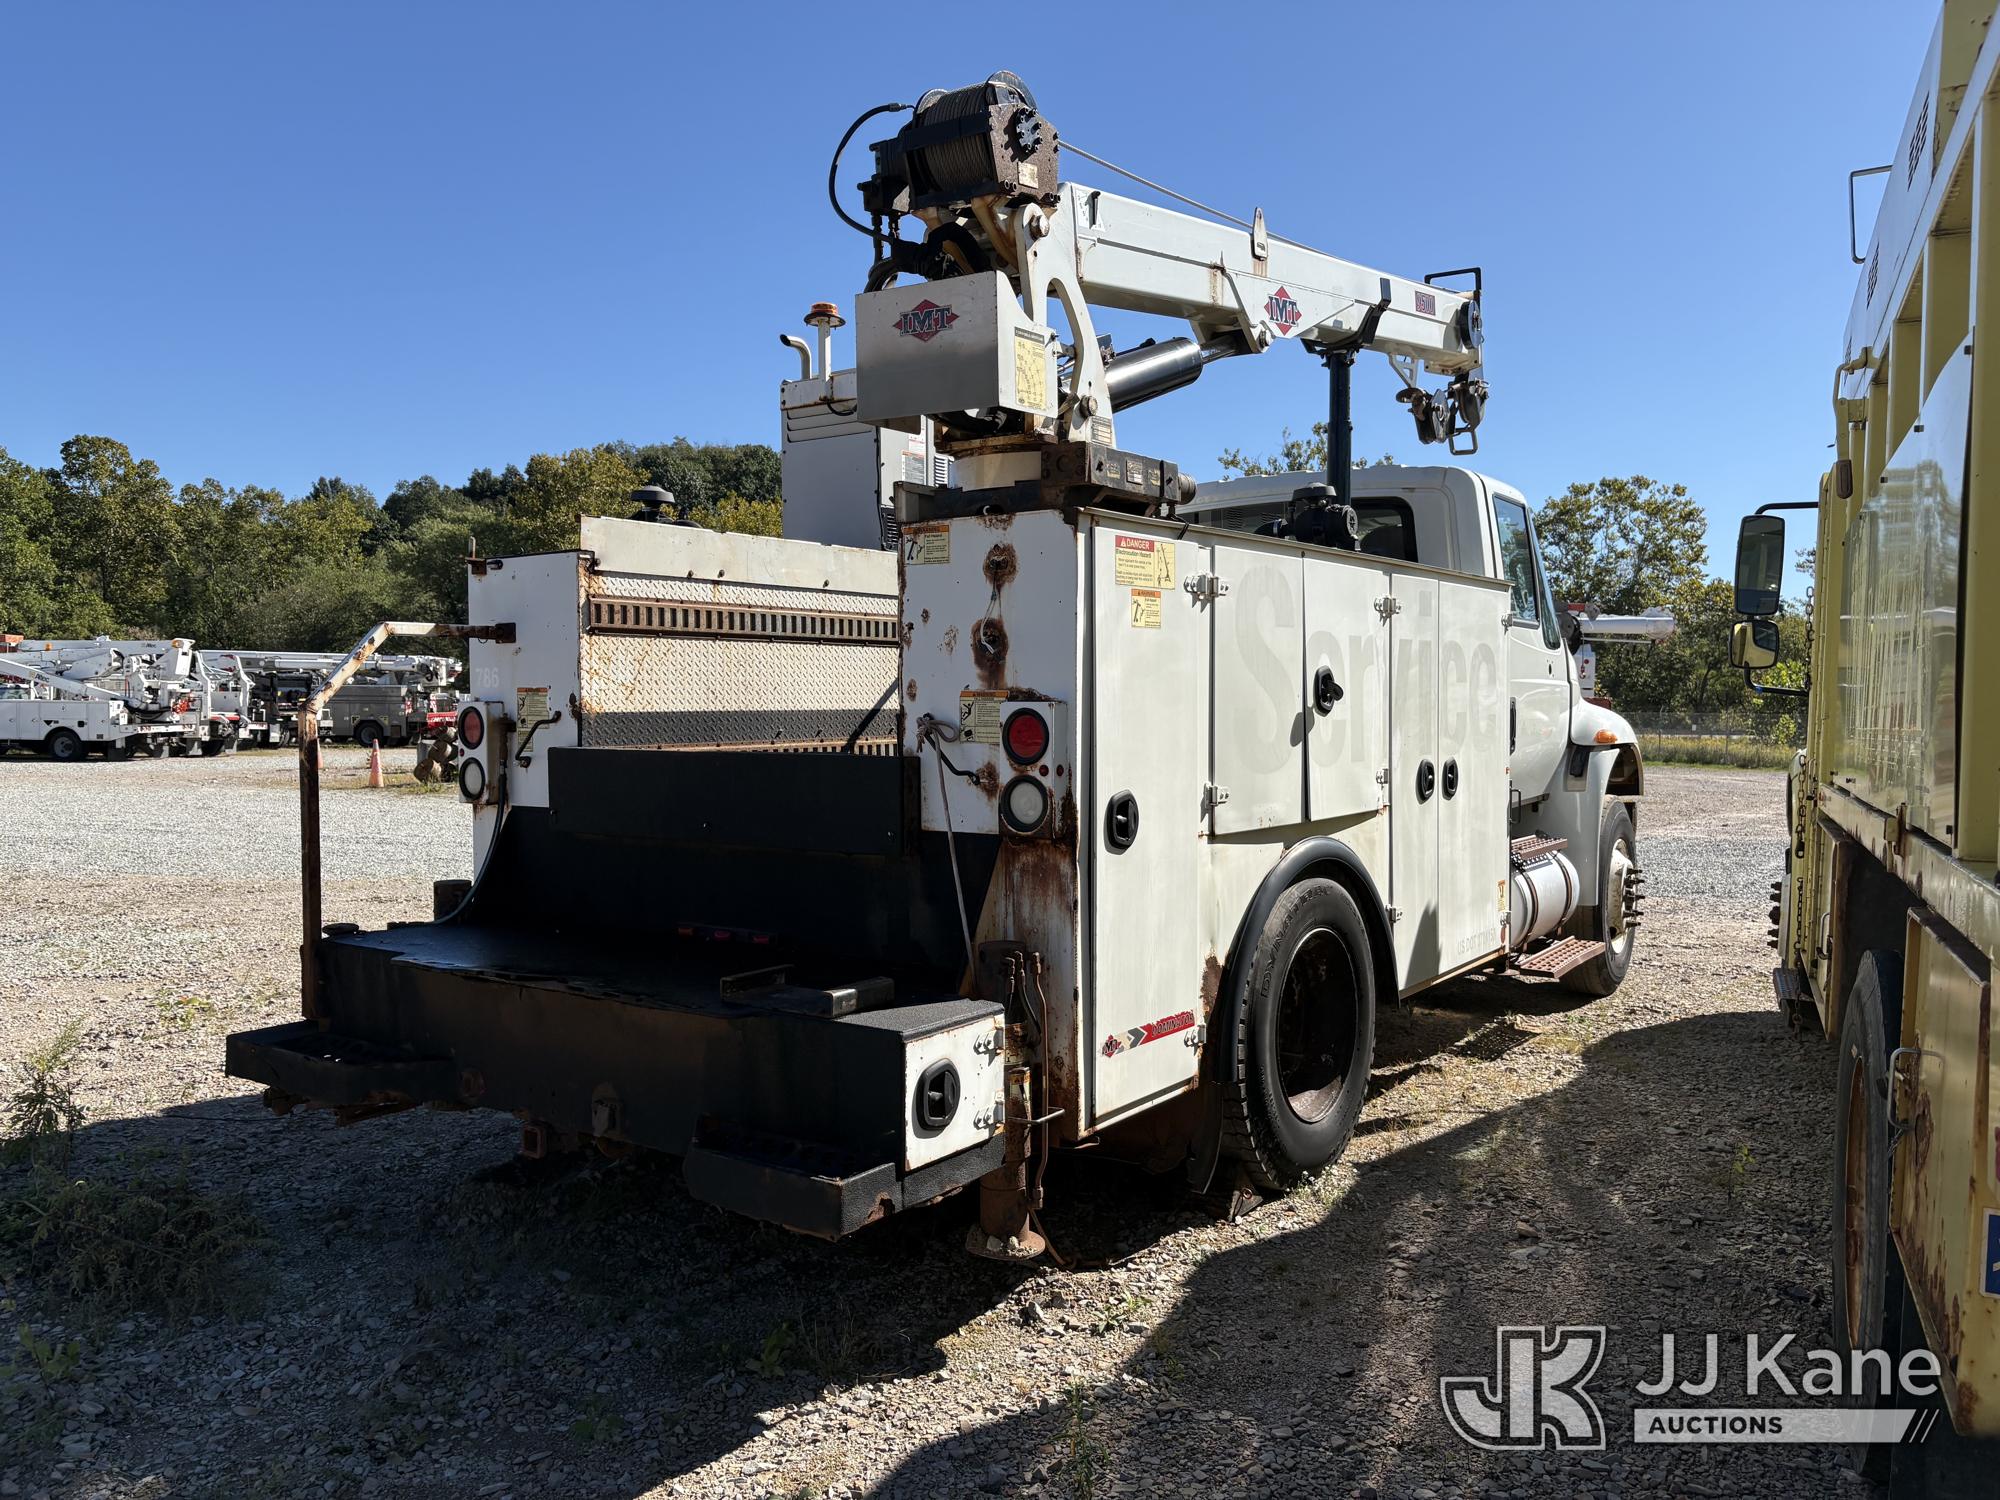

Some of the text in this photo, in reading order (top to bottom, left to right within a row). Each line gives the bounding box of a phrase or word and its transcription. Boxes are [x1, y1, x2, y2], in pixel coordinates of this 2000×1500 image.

[900, 305, 952, 336] IMT
[1268, 295, 1297, 326] IMT
[1126, 538, 1150, 550] DANGER
[475, 667, 500, 688] 786
[1233, 565, 1498, 776] Service
